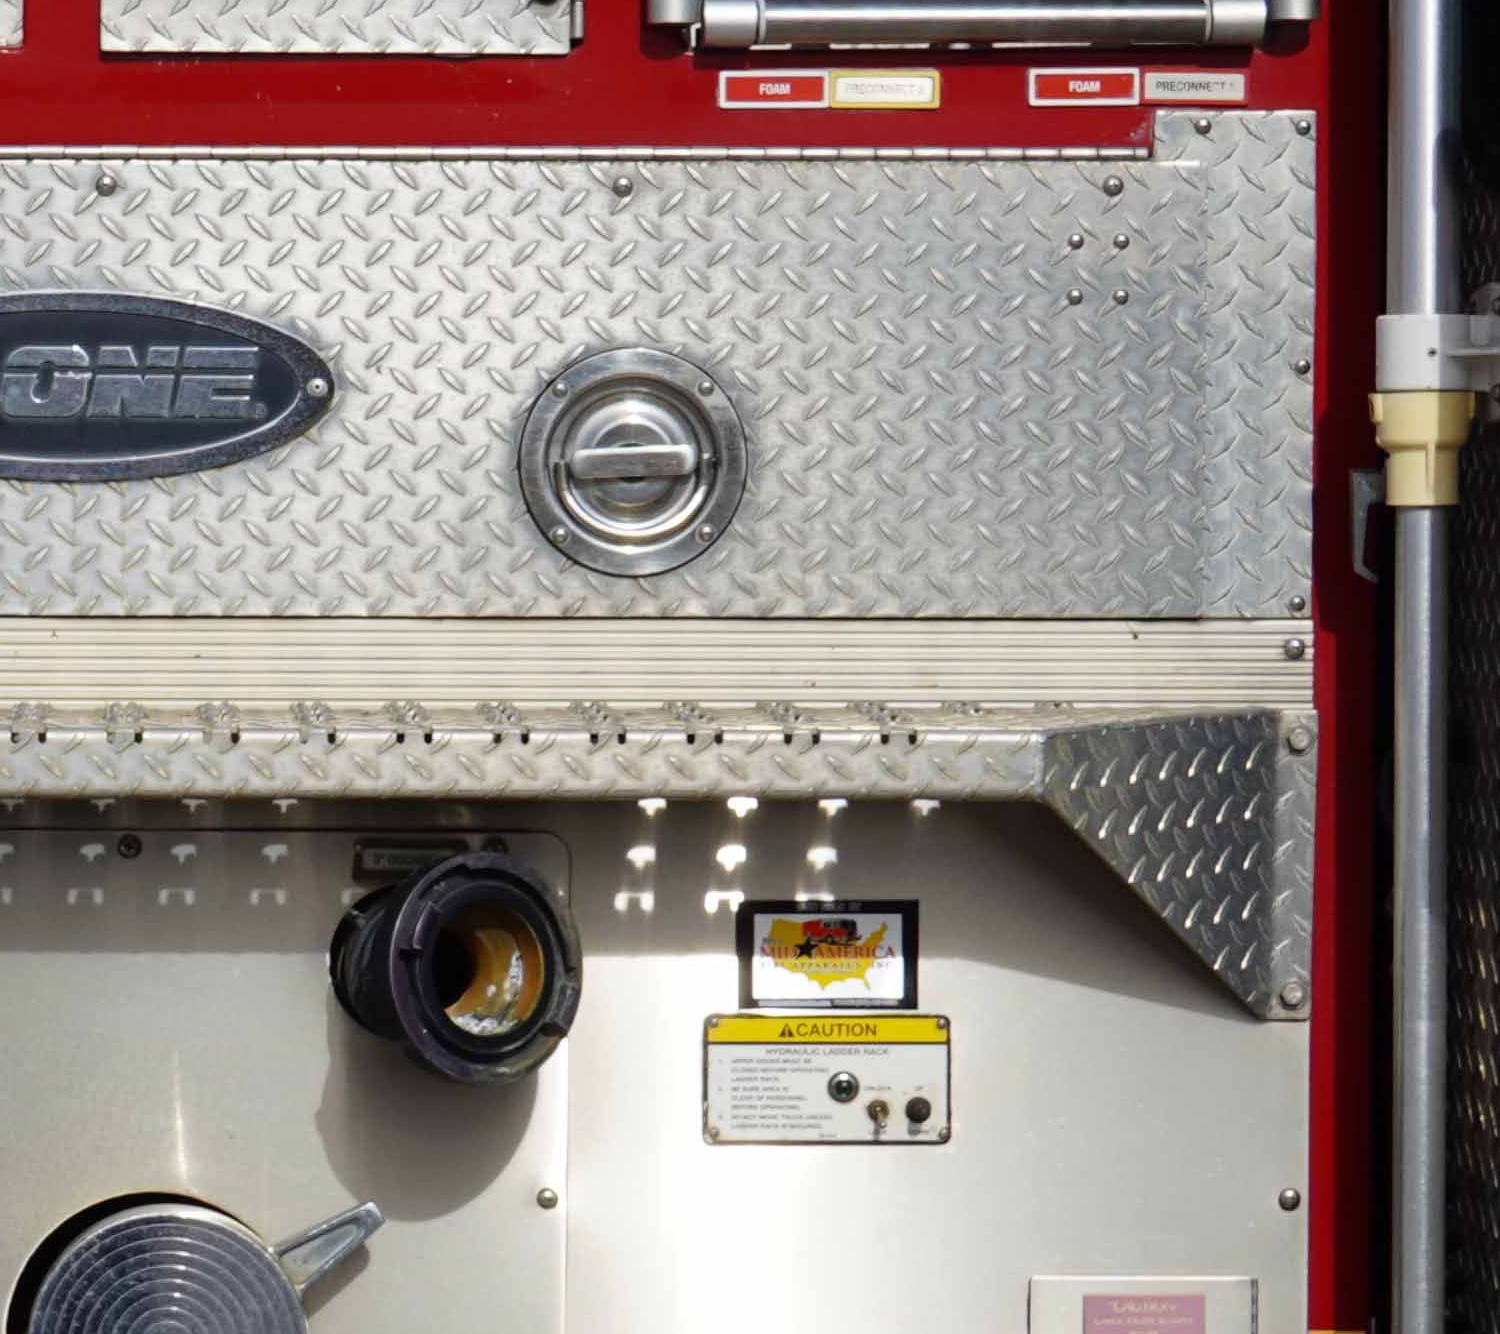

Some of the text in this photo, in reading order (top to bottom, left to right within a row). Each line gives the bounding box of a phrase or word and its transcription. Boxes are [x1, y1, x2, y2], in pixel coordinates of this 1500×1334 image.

[759, 83, 791, 95] FOAM
[1069, 80, 1101, 93] FOAM
[813, 945, 897, 959] AMERICA
[796, 1023, 877, 1037] CAUTION
[823, 1047, 861, 1056] LADDER
[864, 1047, 889, 1056] RACK
